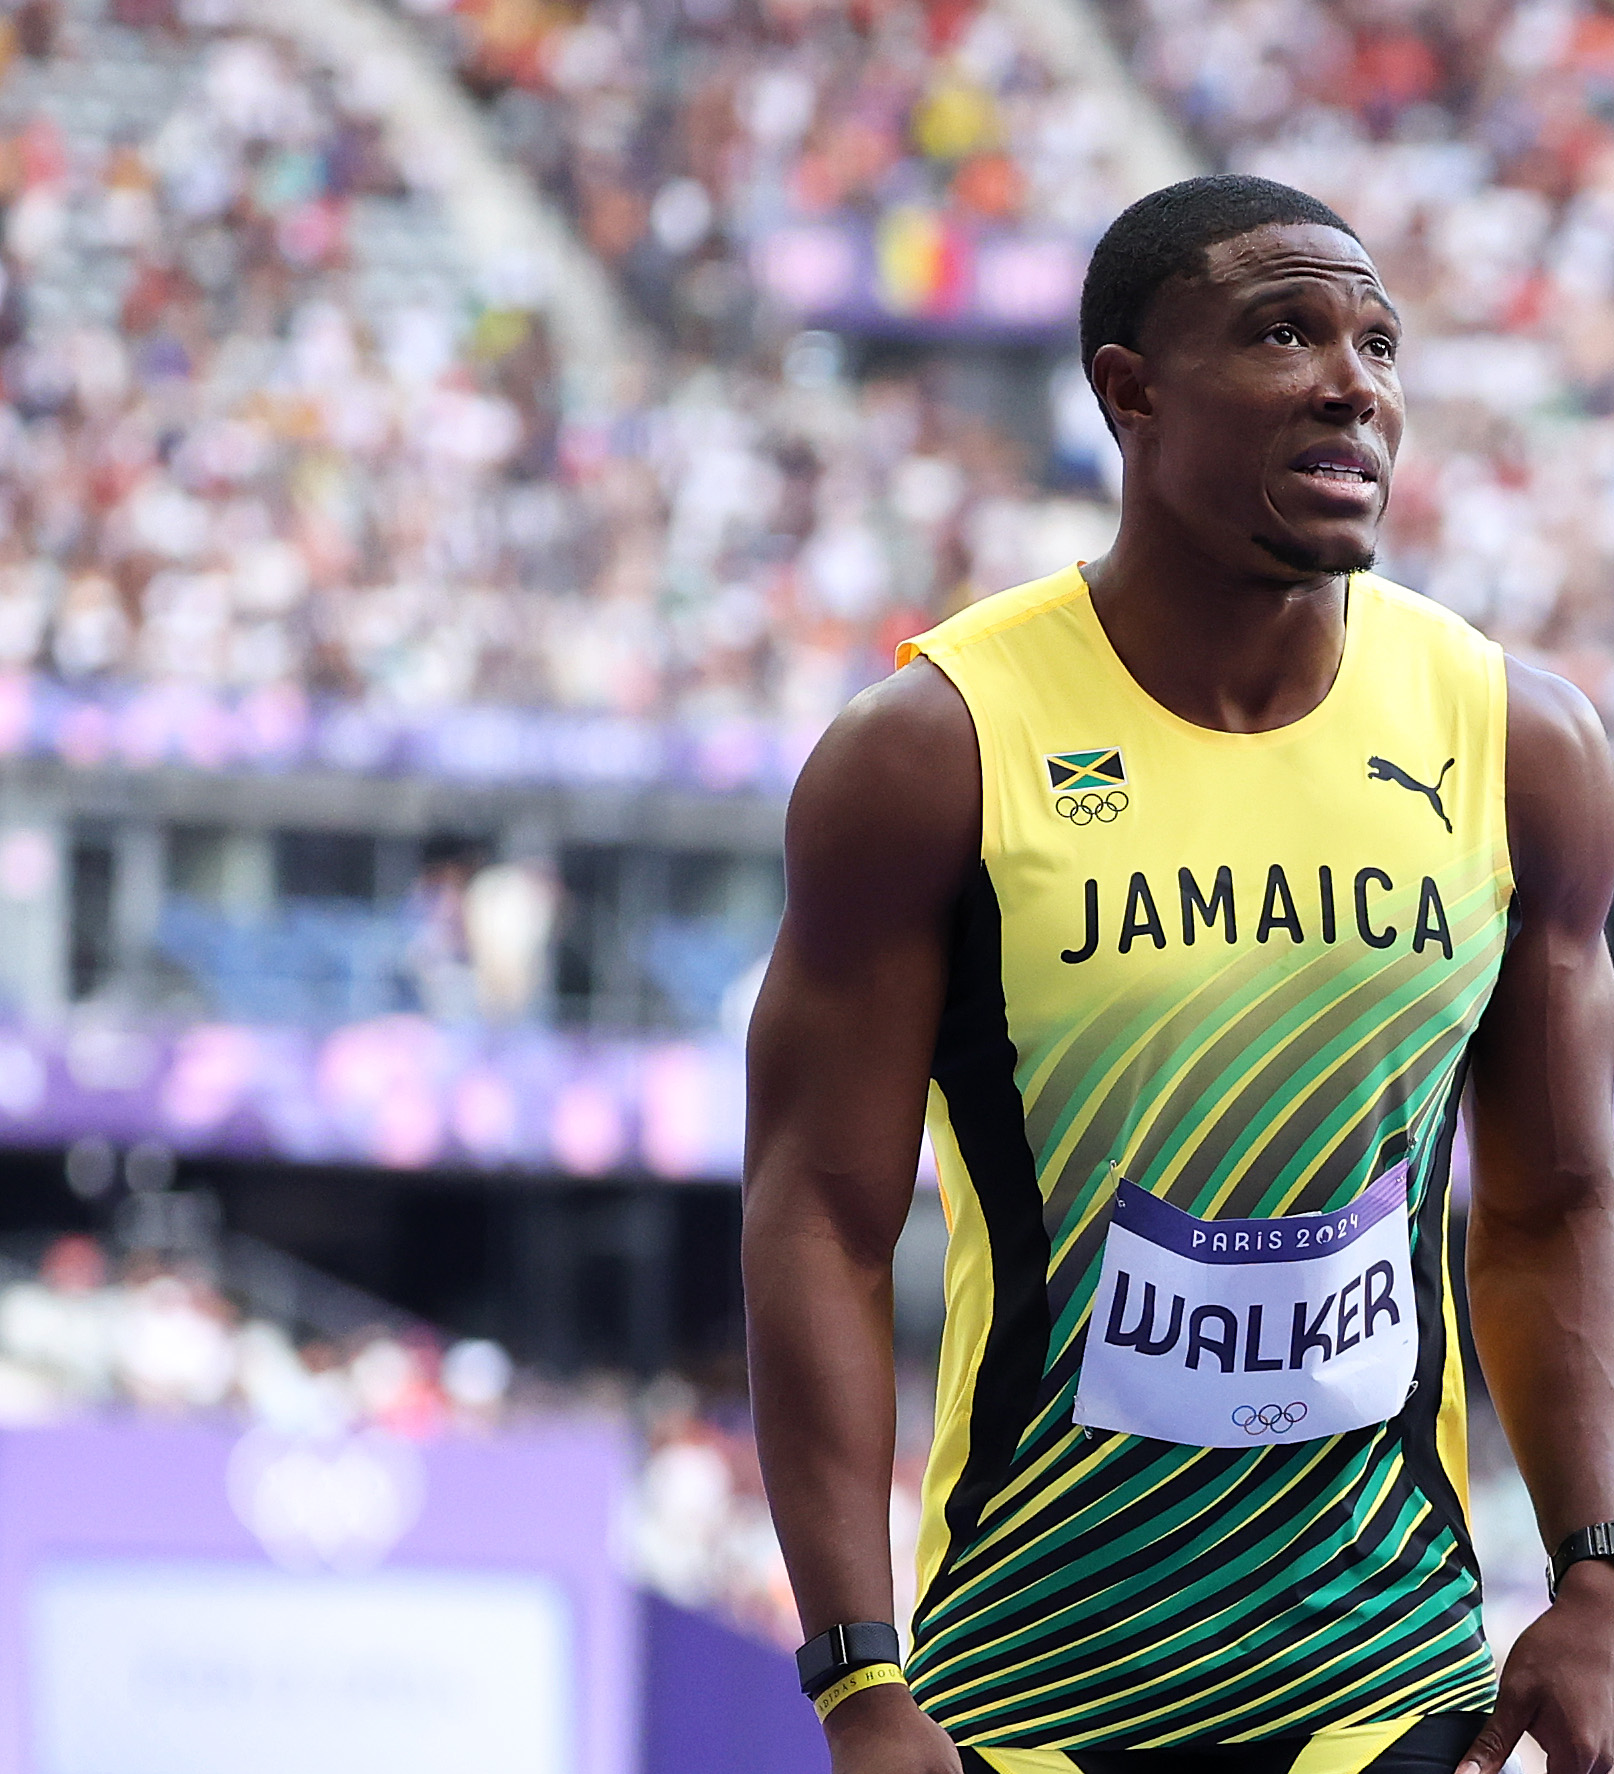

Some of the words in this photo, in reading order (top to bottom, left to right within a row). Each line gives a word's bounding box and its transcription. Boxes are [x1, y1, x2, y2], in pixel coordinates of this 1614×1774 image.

[1060, 863, 1453, 965] JAMAICA
[1295, 1212, 1359, 1248] 2024
[1103, 1258, 1401, 1374] WALKER
